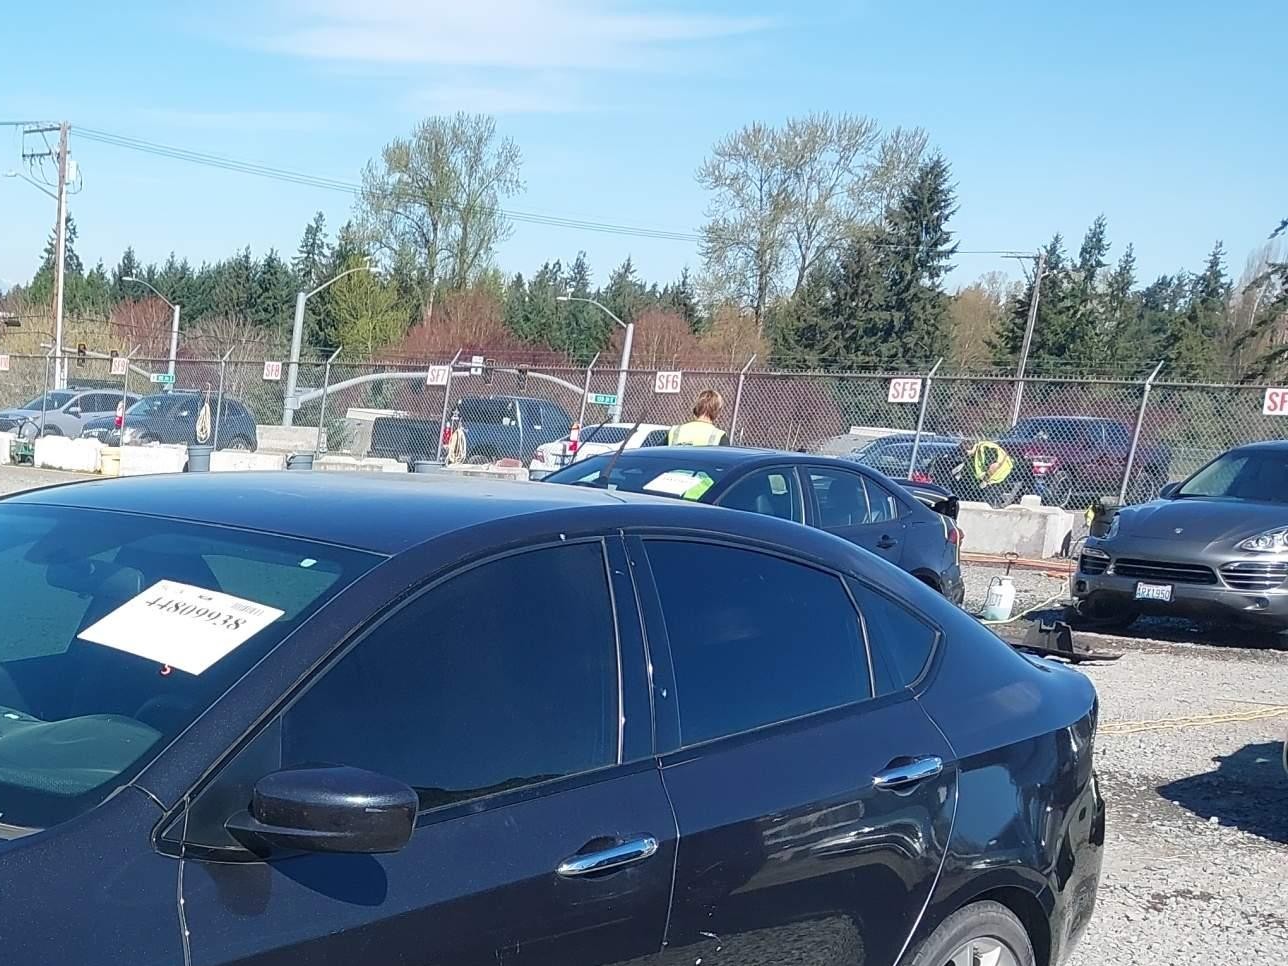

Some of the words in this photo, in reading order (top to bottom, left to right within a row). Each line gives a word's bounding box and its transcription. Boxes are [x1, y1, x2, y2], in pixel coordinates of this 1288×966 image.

[265, 364, 280, 378] SF8
[430, 369, 447, 382] SF7
[658, 375, 678, 389] SF6
[892, 382, 917, 398] SF5
[145, 596, 247, 630] 44809938
